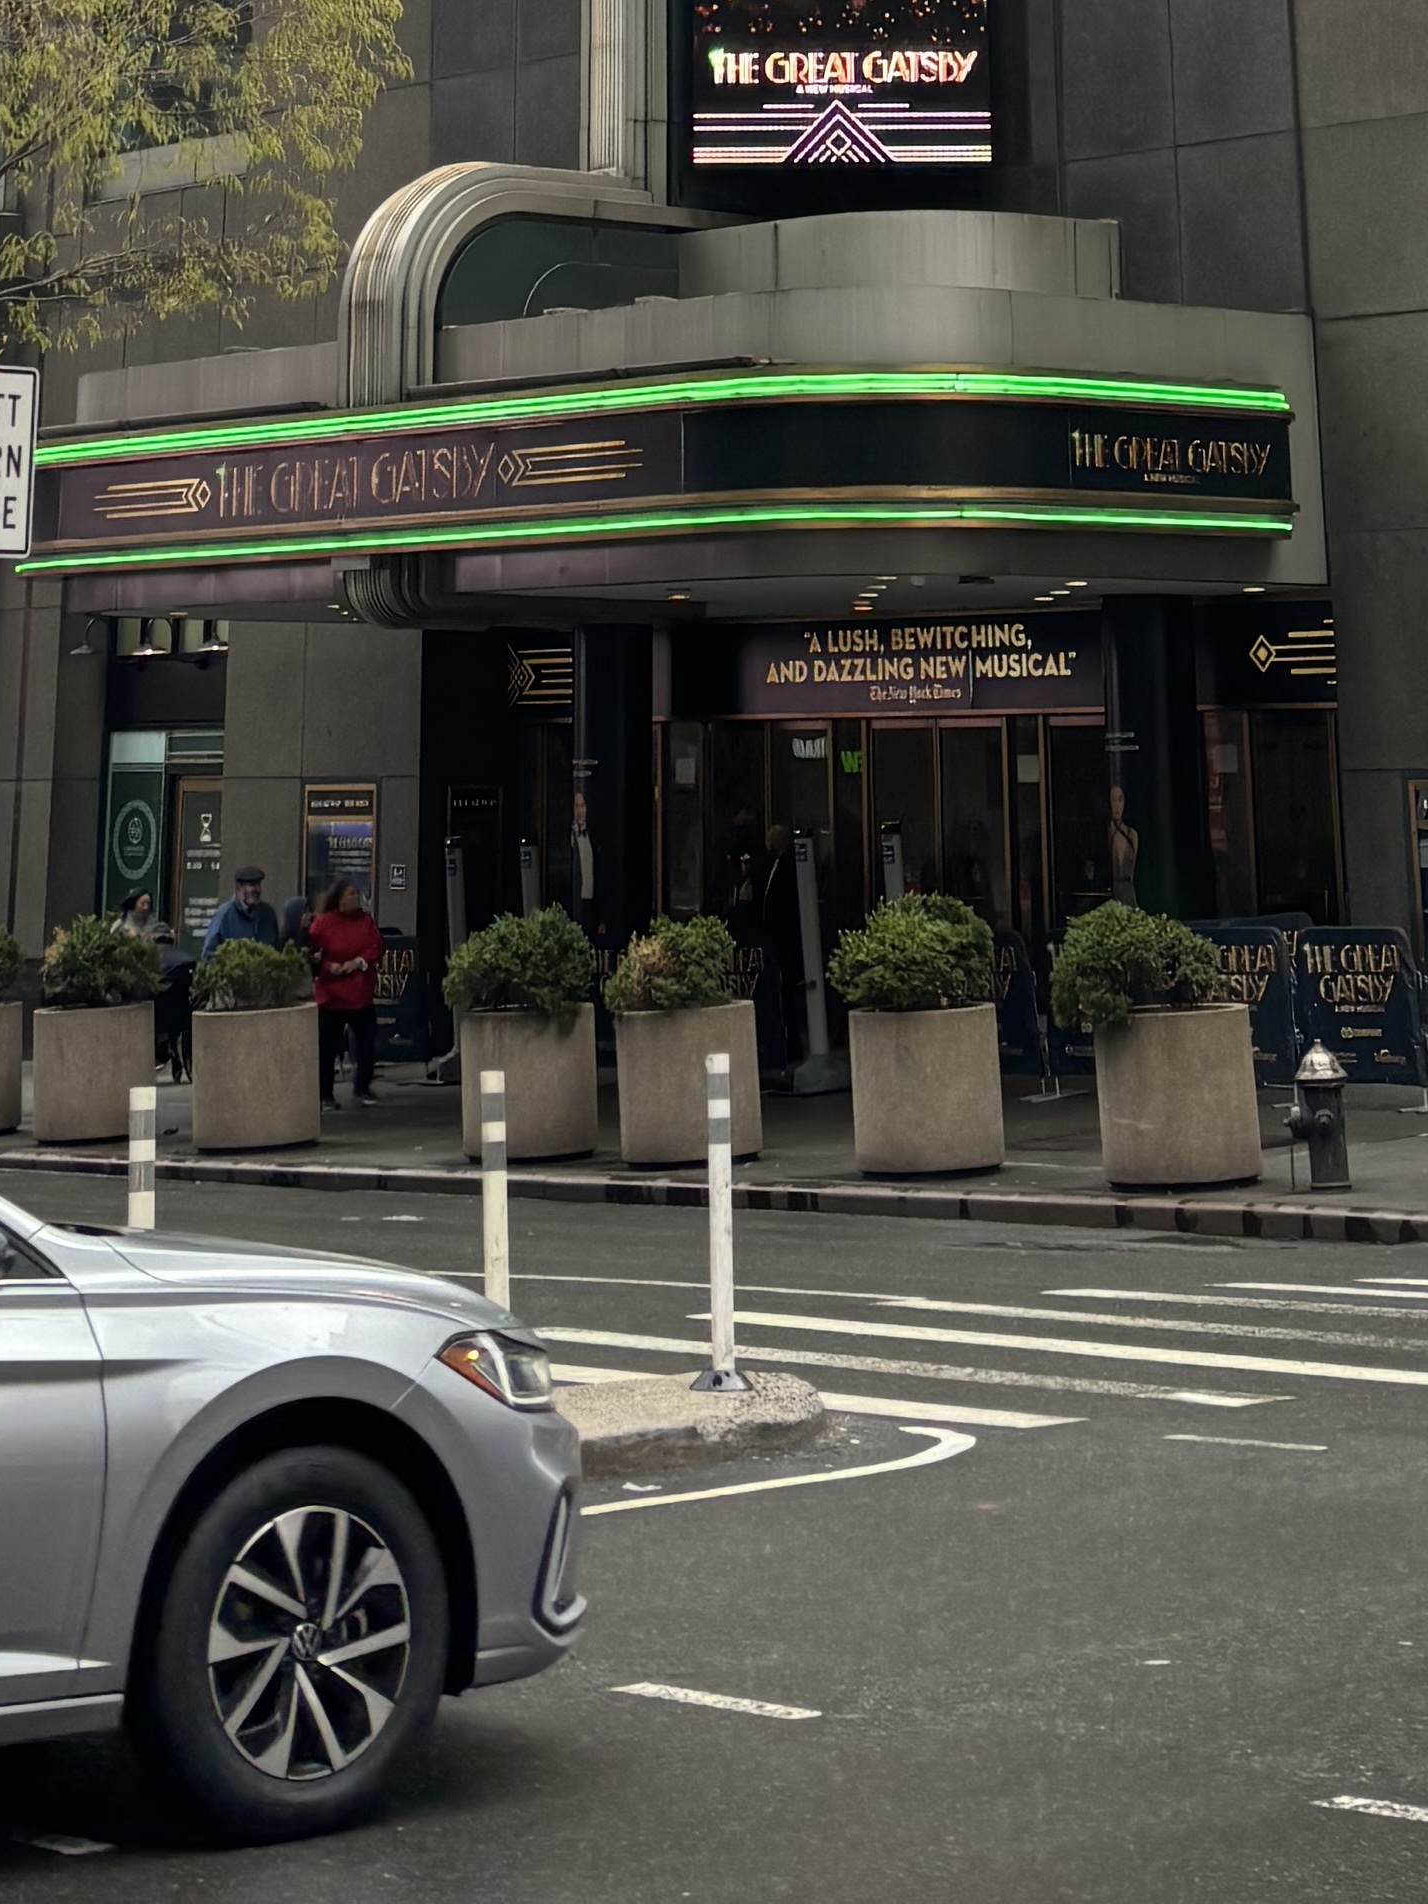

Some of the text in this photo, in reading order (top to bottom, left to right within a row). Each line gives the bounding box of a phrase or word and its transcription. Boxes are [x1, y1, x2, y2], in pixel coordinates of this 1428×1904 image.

[709, 49, 978, 84] THE GREAT GATSBY
[1072, 430, 1271, 476] THE GREAT GATSBY
[216, 442, 495, 517] THE GREAT GATSBY
[828, 629, 884, 655] LUSH,
[891, 624, 1032, 650] BEWITCHING,
[766, 660, 807, 684] AND
[813, 657, 914, 682] DAZZLING
[920, 655, 966, 679] NEW
[1304, 944, 1400, 973] THE GREAT
[1207, 975, 1269, 1002] ATSBY
[1320, 975, 1394, 1003] GATSBY
